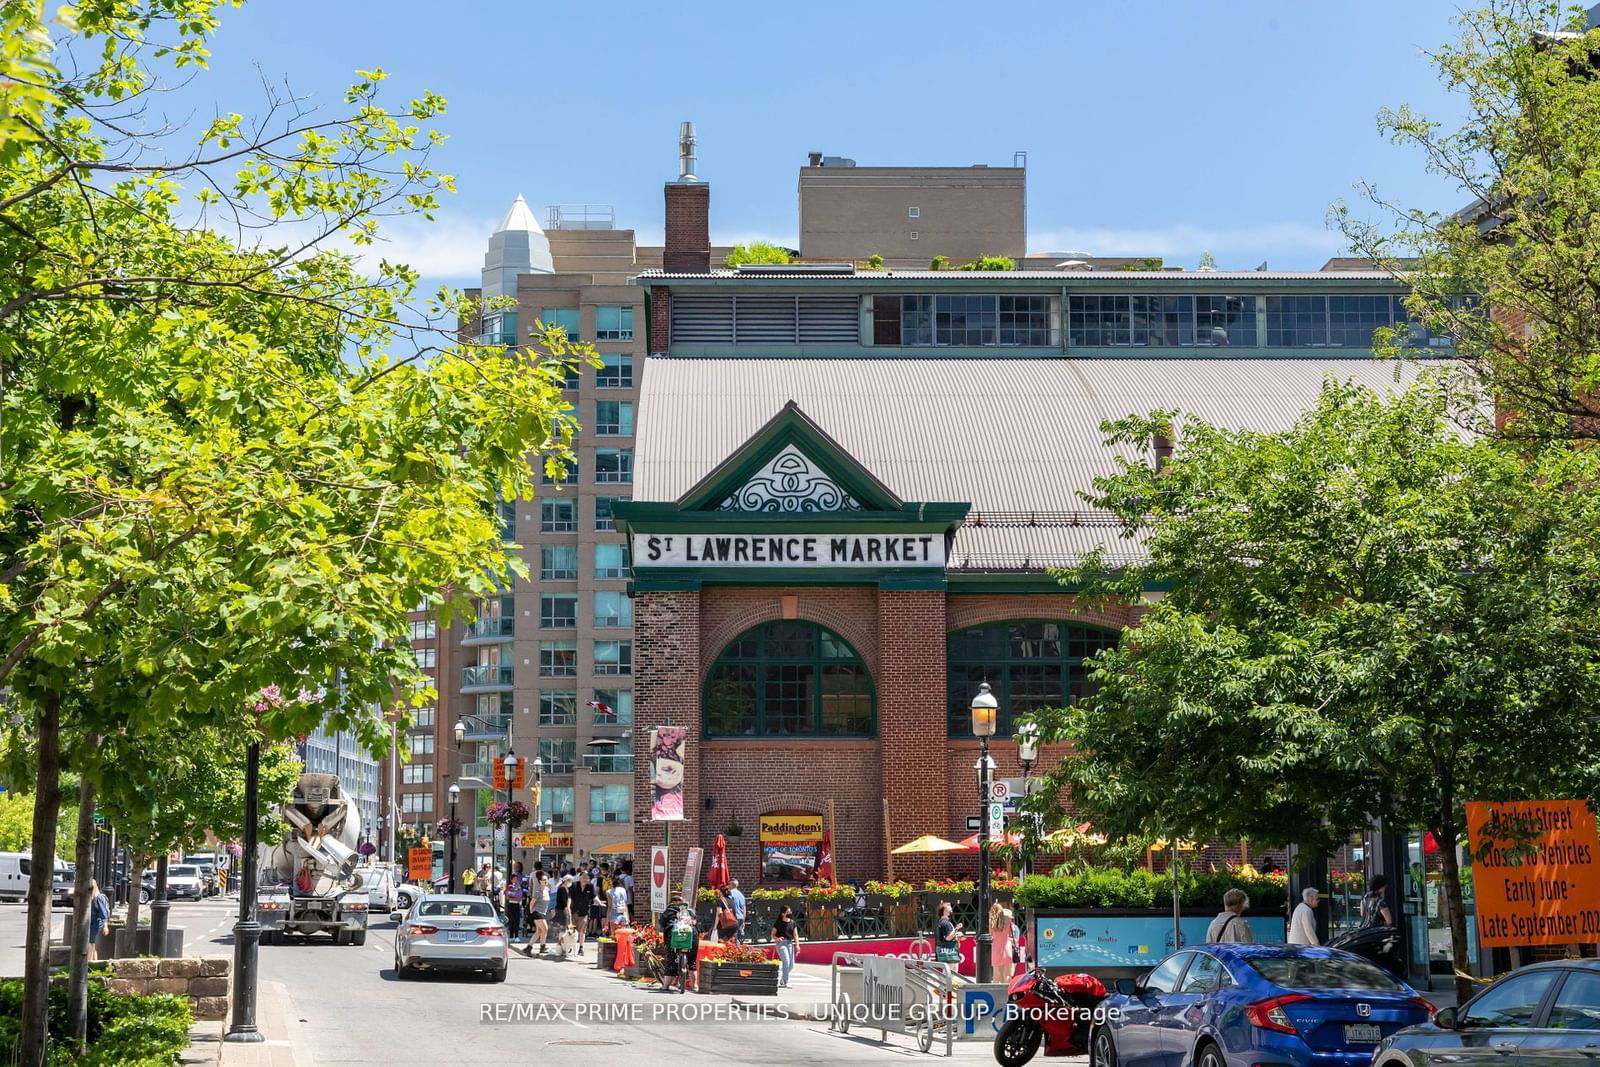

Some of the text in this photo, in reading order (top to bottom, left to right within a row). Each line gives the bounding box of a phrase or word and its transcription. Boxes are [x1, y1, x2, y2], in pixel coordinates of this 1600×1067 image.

[686, 537, 817, 561] LAWRENCE
[831, 537, 932, 561] MARKET
[762, 822, 821, 835] Paddington's
[1491, 807, 1573, 832] Market Street
[1540, 840, 1591, 865] Vehicles
[1505, 876, 1536, 907] Early
[1540, 877, 1568, 900] June
[1481, 914, 1508, 938] Late
[1511, 910, 1577, 943] September
[966, 991, 994, 1034] P
